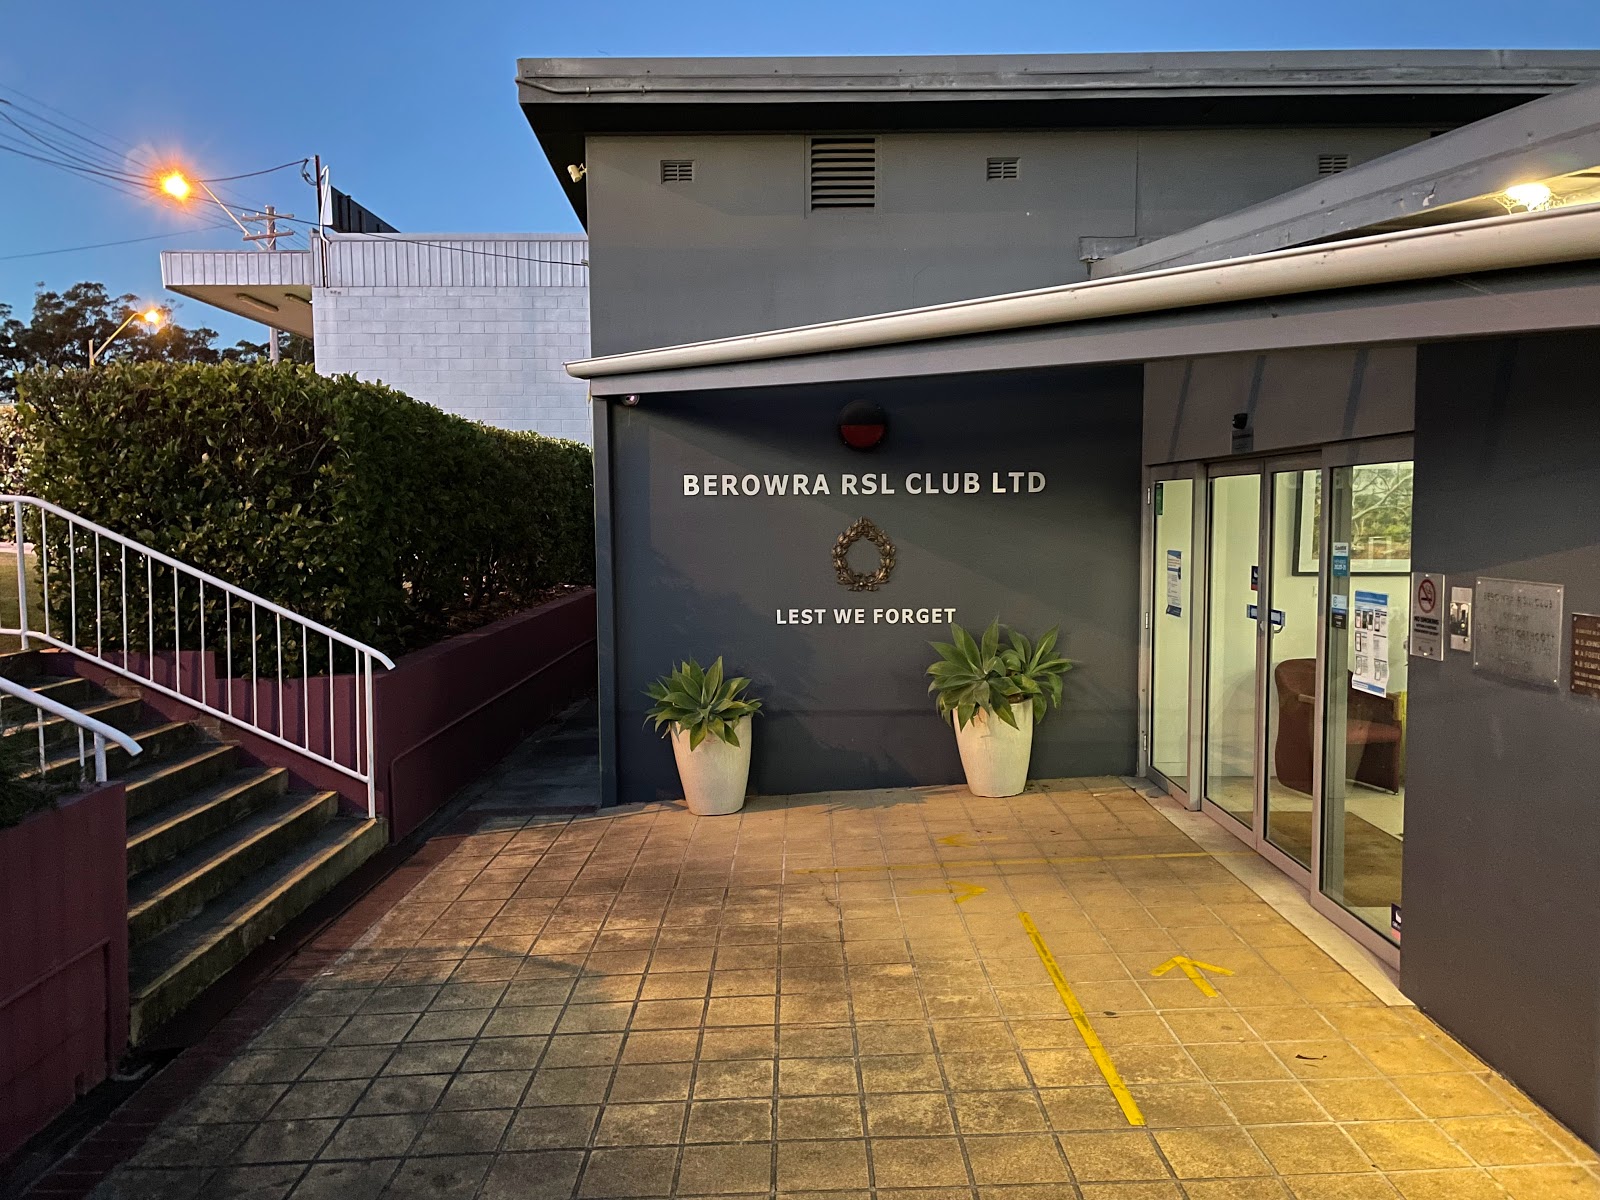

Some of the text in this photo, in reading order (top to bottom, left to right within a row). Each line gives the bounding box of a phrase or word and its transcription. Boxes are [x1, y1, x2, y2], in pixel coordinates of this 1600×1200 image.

[683, 471, 1046, 496] BEROWRA RSL CLUB LTD
[776, 608, 957, 625] LEST WE FORGET
